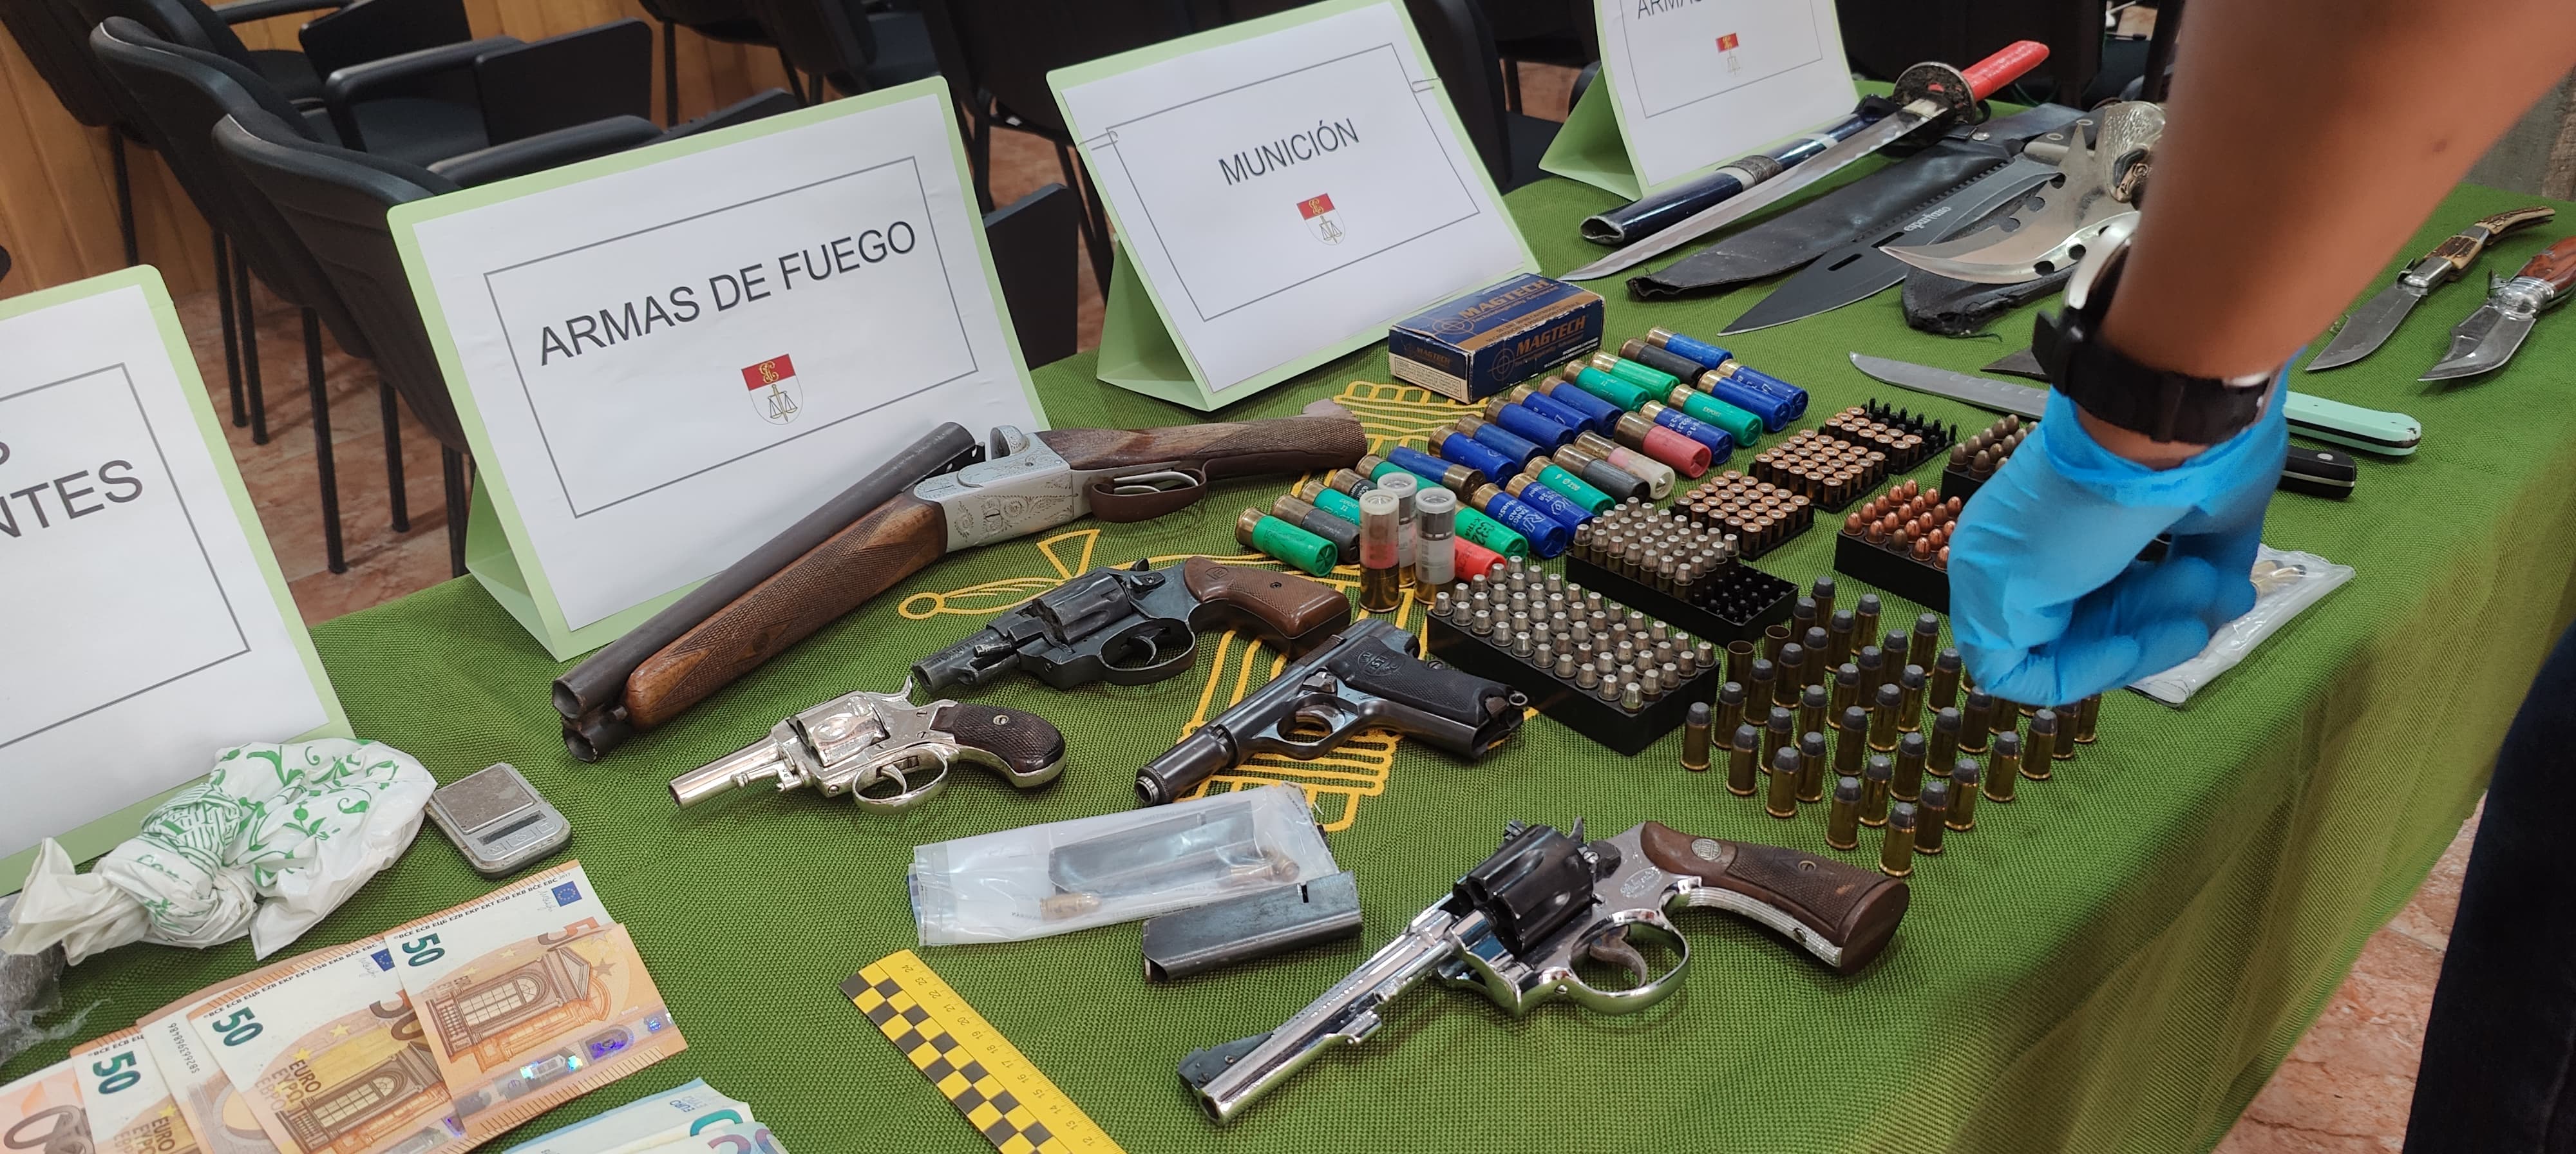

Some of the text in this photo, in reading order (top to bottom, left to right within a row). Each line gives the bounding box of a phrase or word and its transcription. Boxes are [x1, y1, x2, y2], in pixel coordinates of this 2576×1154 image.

[1638, 0, 1701, 19] ARM
[1217, 118, 1359, 186] MUNICIÓN
[540, 220, 916, 366] ARMAS DE FUEGO
[1459, 279, 1549, 319] MAGTECH
[1517, 315, 1586, 356] MAGTECH
[415, 925, 430, 933] ECB
[449, 913, 464, 922] EZB
[464, 907, 480, 916] EKP
[512, 890, 527, 898] EKB
[544, 878, 558, 886] EBC
[401, 932, 446, 967] 50
[226, 999, 242, 1008] ECB
[261, 983, 277, 992] EZB
[278, 976, 294, 985] EKP
[312, 963, 327, 972] ESB
[328, 956, 344, 965] EKB
[362, 943, 378, 952] EBC
[113, 1040, 129, 1048] ECB
[212, 1007, 263, 1047] 50
[92, 1050, 141, 1095] 50
[902, 964, 1095, 1146] 12 13 14 15 16 17 18 19 20 21 22 23 24
[289, 1059, 321, 1093] EURO
[151, 1116, 176, 1152] EURO
